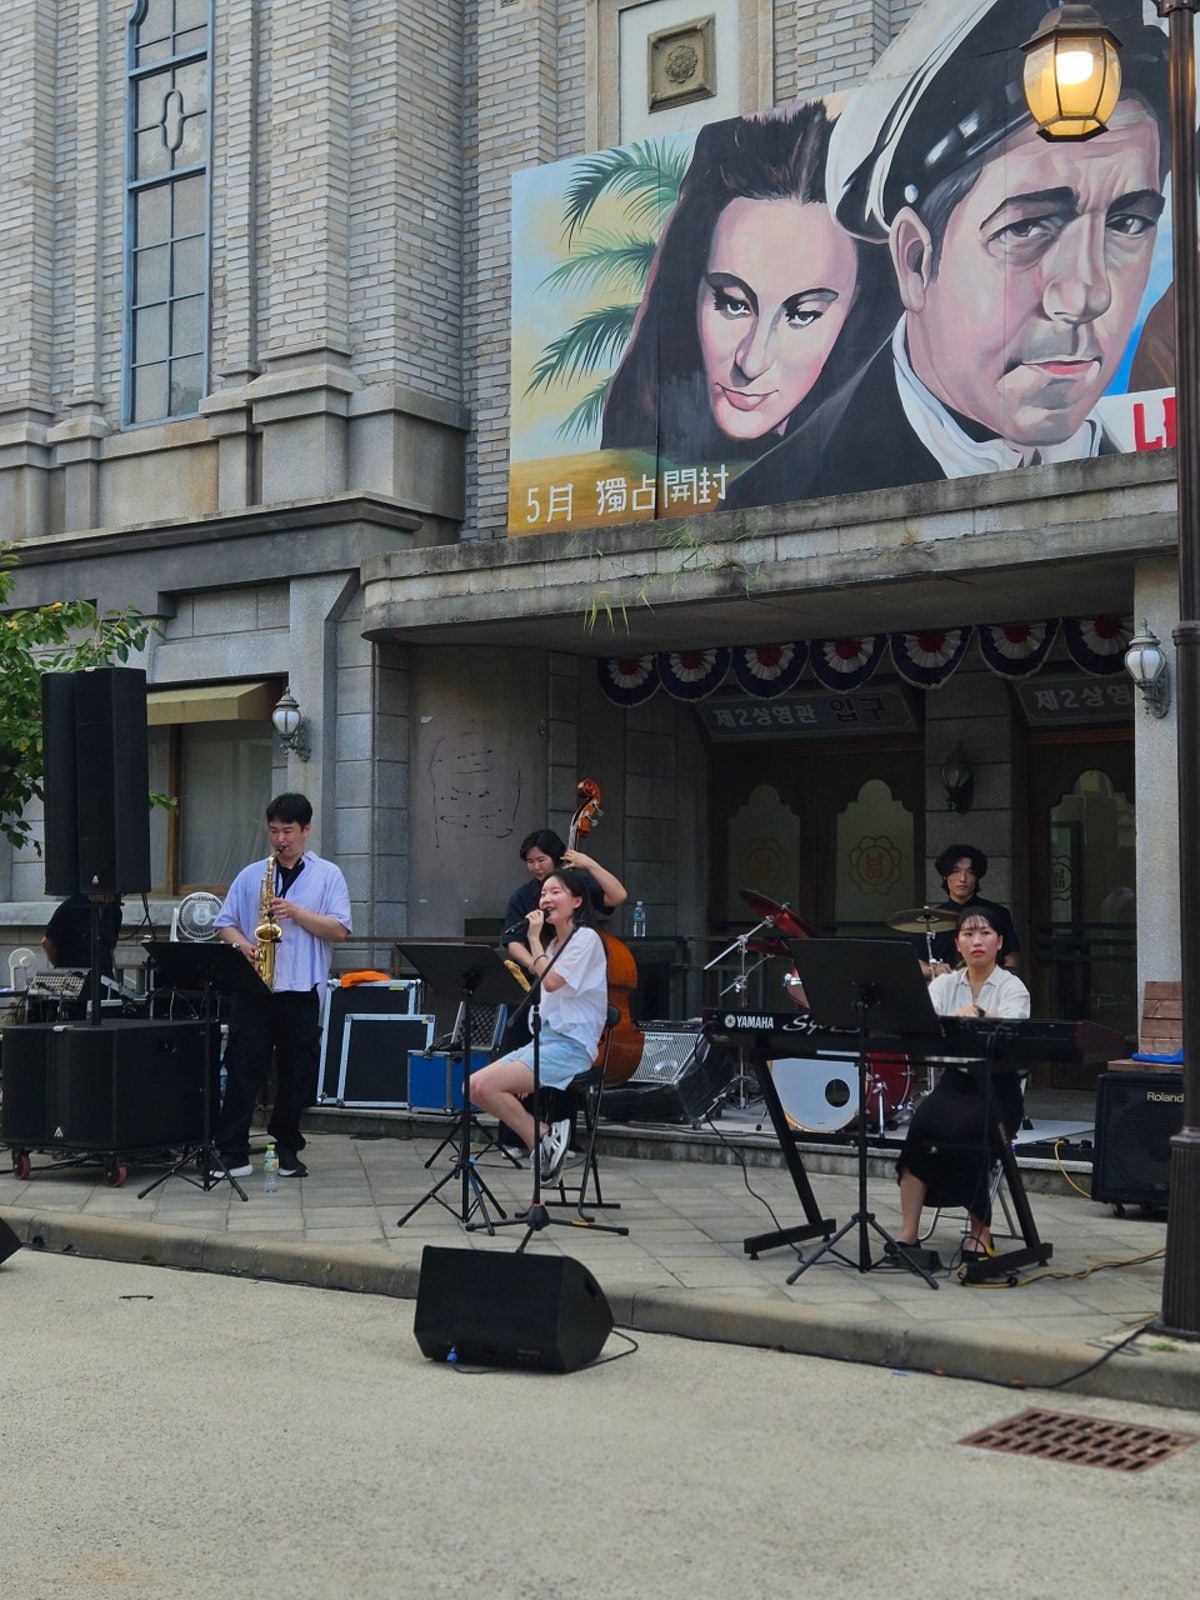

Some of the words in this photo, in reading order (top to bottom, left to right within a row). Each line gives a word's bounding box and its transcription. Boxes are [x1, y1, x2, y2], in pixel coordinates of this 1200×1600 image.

[526, 483, 573, 523] 5月
[596, 464, 729, 516] 獨占開封
[714, 704, 818, 728] 제2상영관
[828, 697, 886, 723] 입구
[736, 1015, 774, 1029] YAMAHA
[1146, 1091, 1185, 1104] Roland
